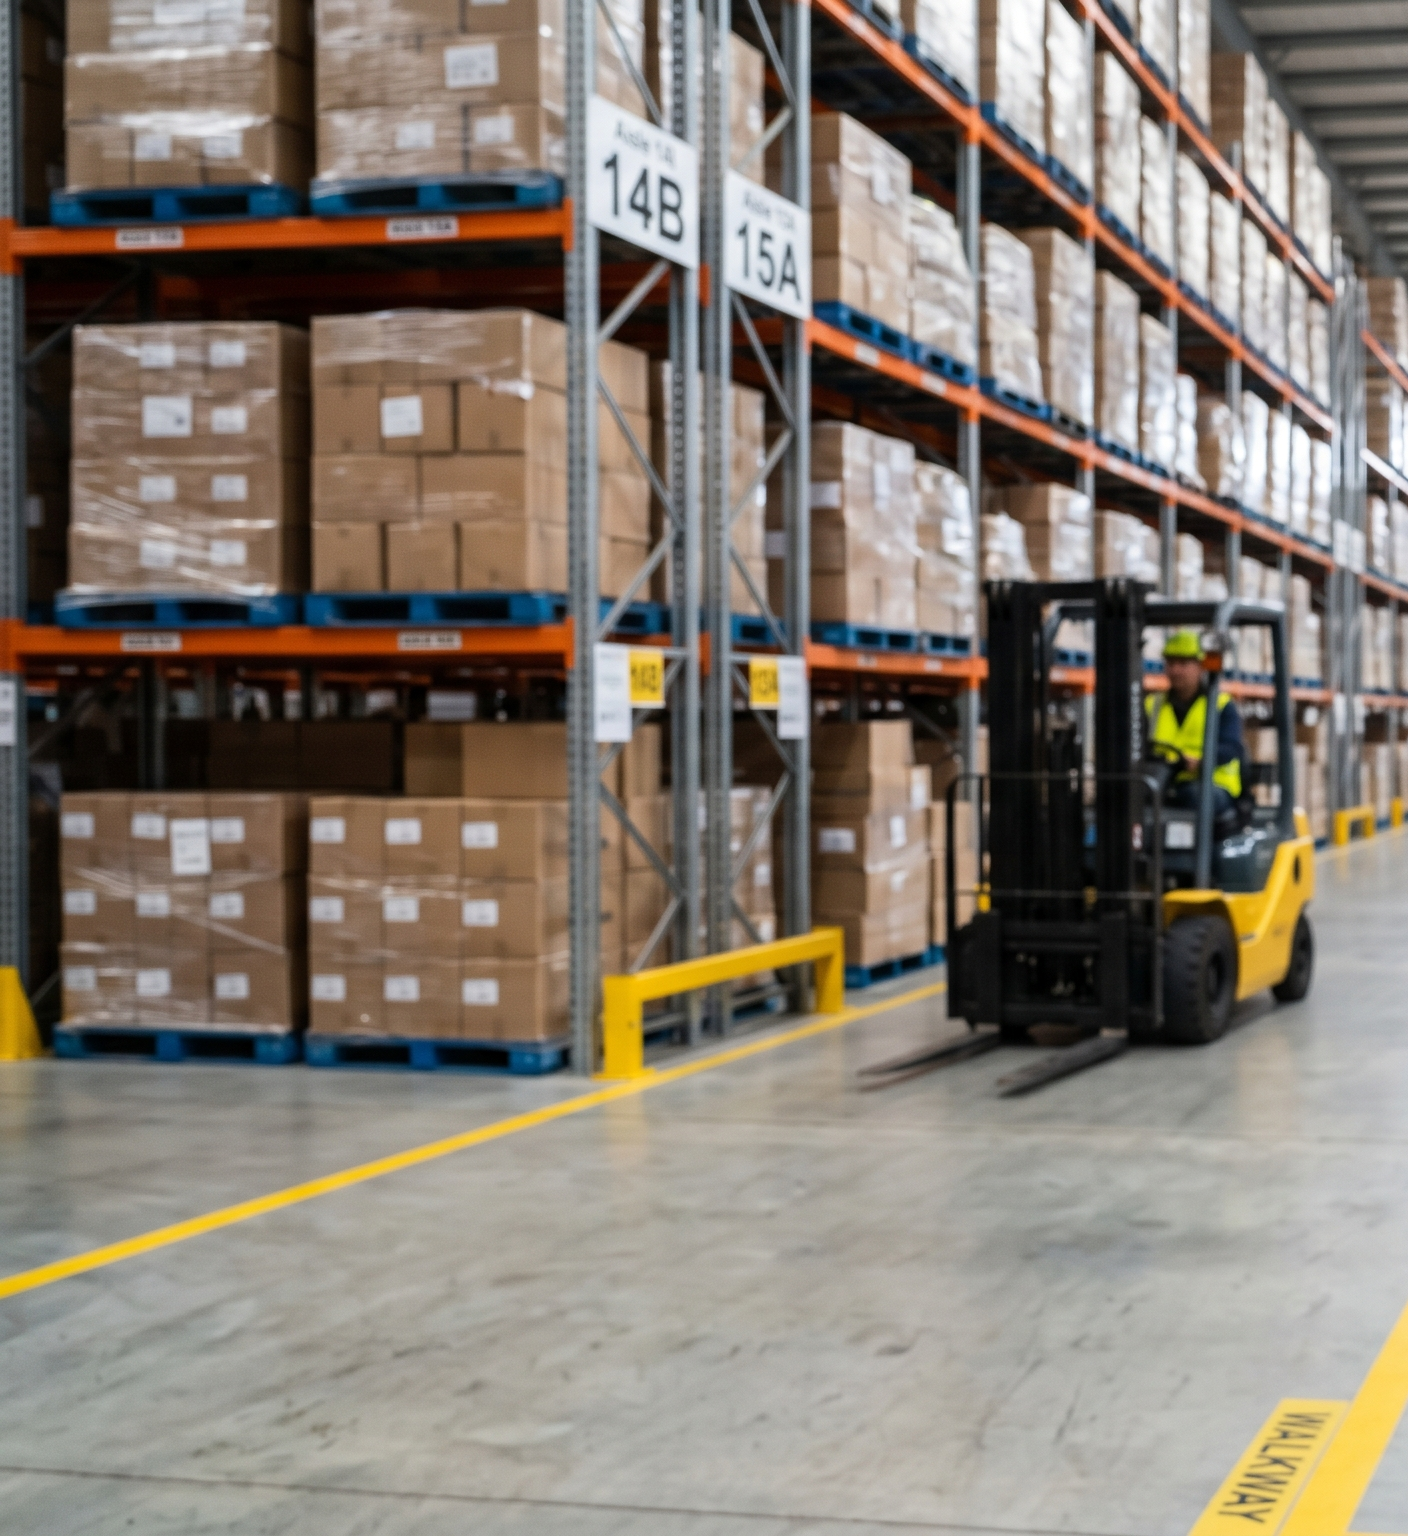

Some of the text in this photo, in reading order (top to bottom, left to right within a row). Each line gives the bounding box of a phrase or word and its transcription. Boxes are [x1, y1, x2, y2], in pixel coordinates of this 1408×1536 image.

[604, 153, 683, 243] 14B
[737, 222, 802, 301] 15A
[1217, 1412, 1332, 1523] WALKWAY
